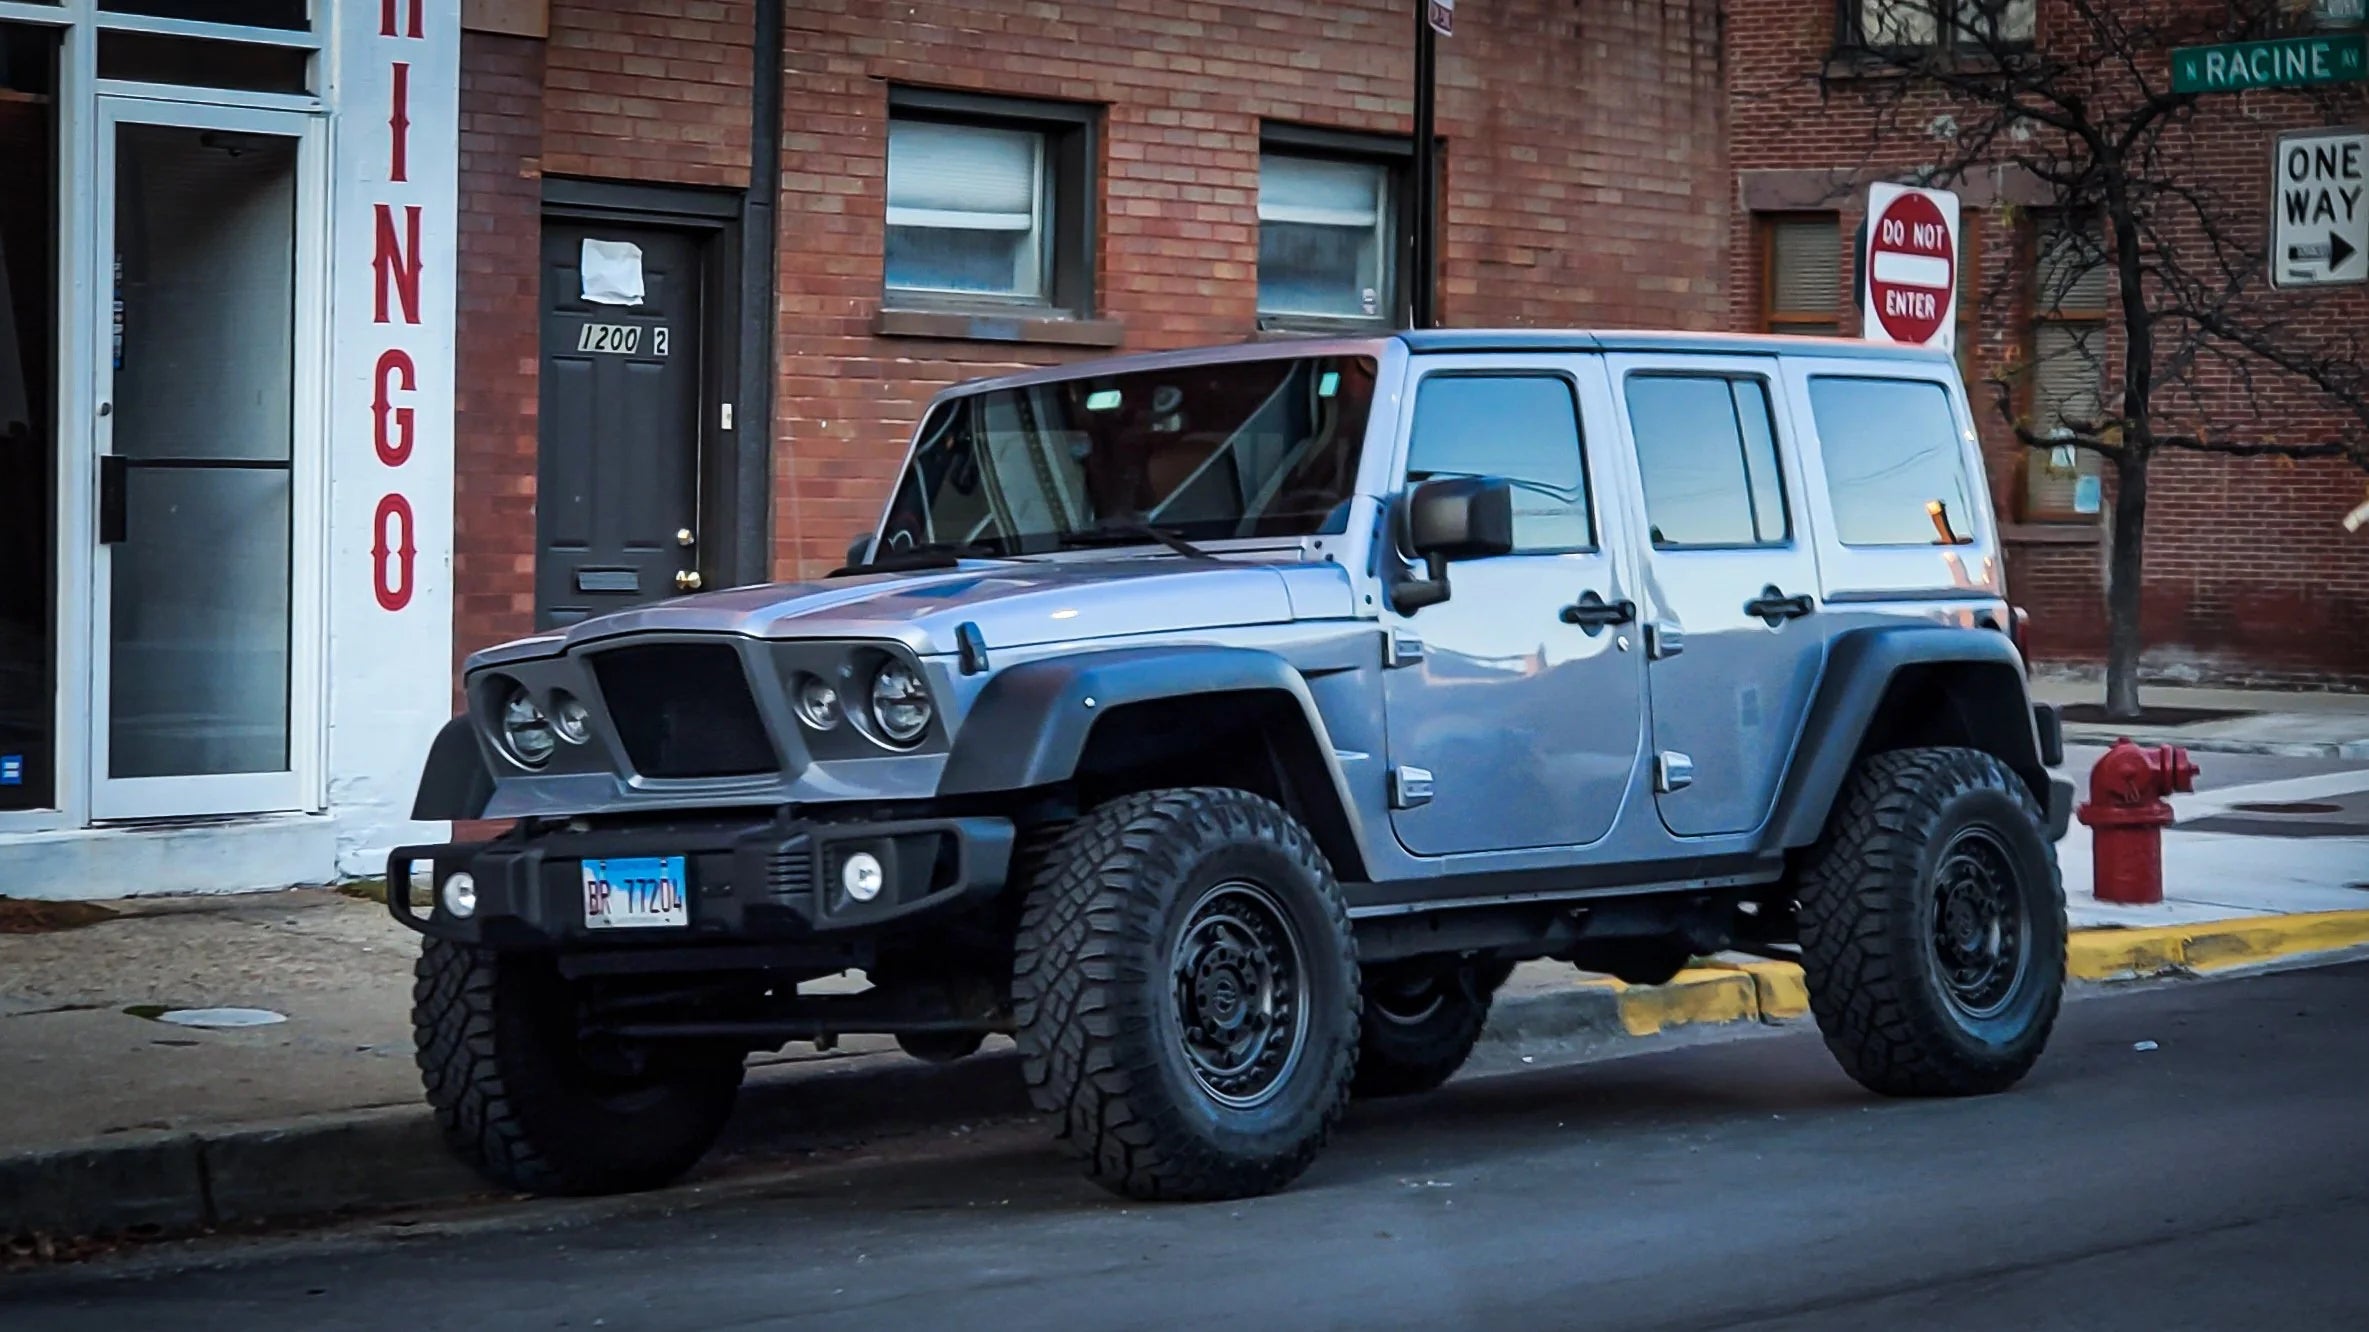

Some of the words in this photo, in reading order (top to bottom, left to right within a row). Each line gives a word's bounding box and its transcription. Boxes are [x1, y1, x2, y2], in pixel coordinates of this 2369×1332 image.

[2186, 60, 2197, 81] N
[2206, 43, 2332, 86] RACINE
[2288, 142, 2362, 182] ONE
[2285, 185, 2363, 226] WAY
[1882, 218, 1905, 246] DO
[1913, 222, 1945, 250] NOT
[1886, 289, 1936, 320] ENTER
[583, 325, 638, 352] 1200
[656, 330, 666, 354] 2
[588, 880, 612, 916] BR
[623, 877, 682, 914] 77204
